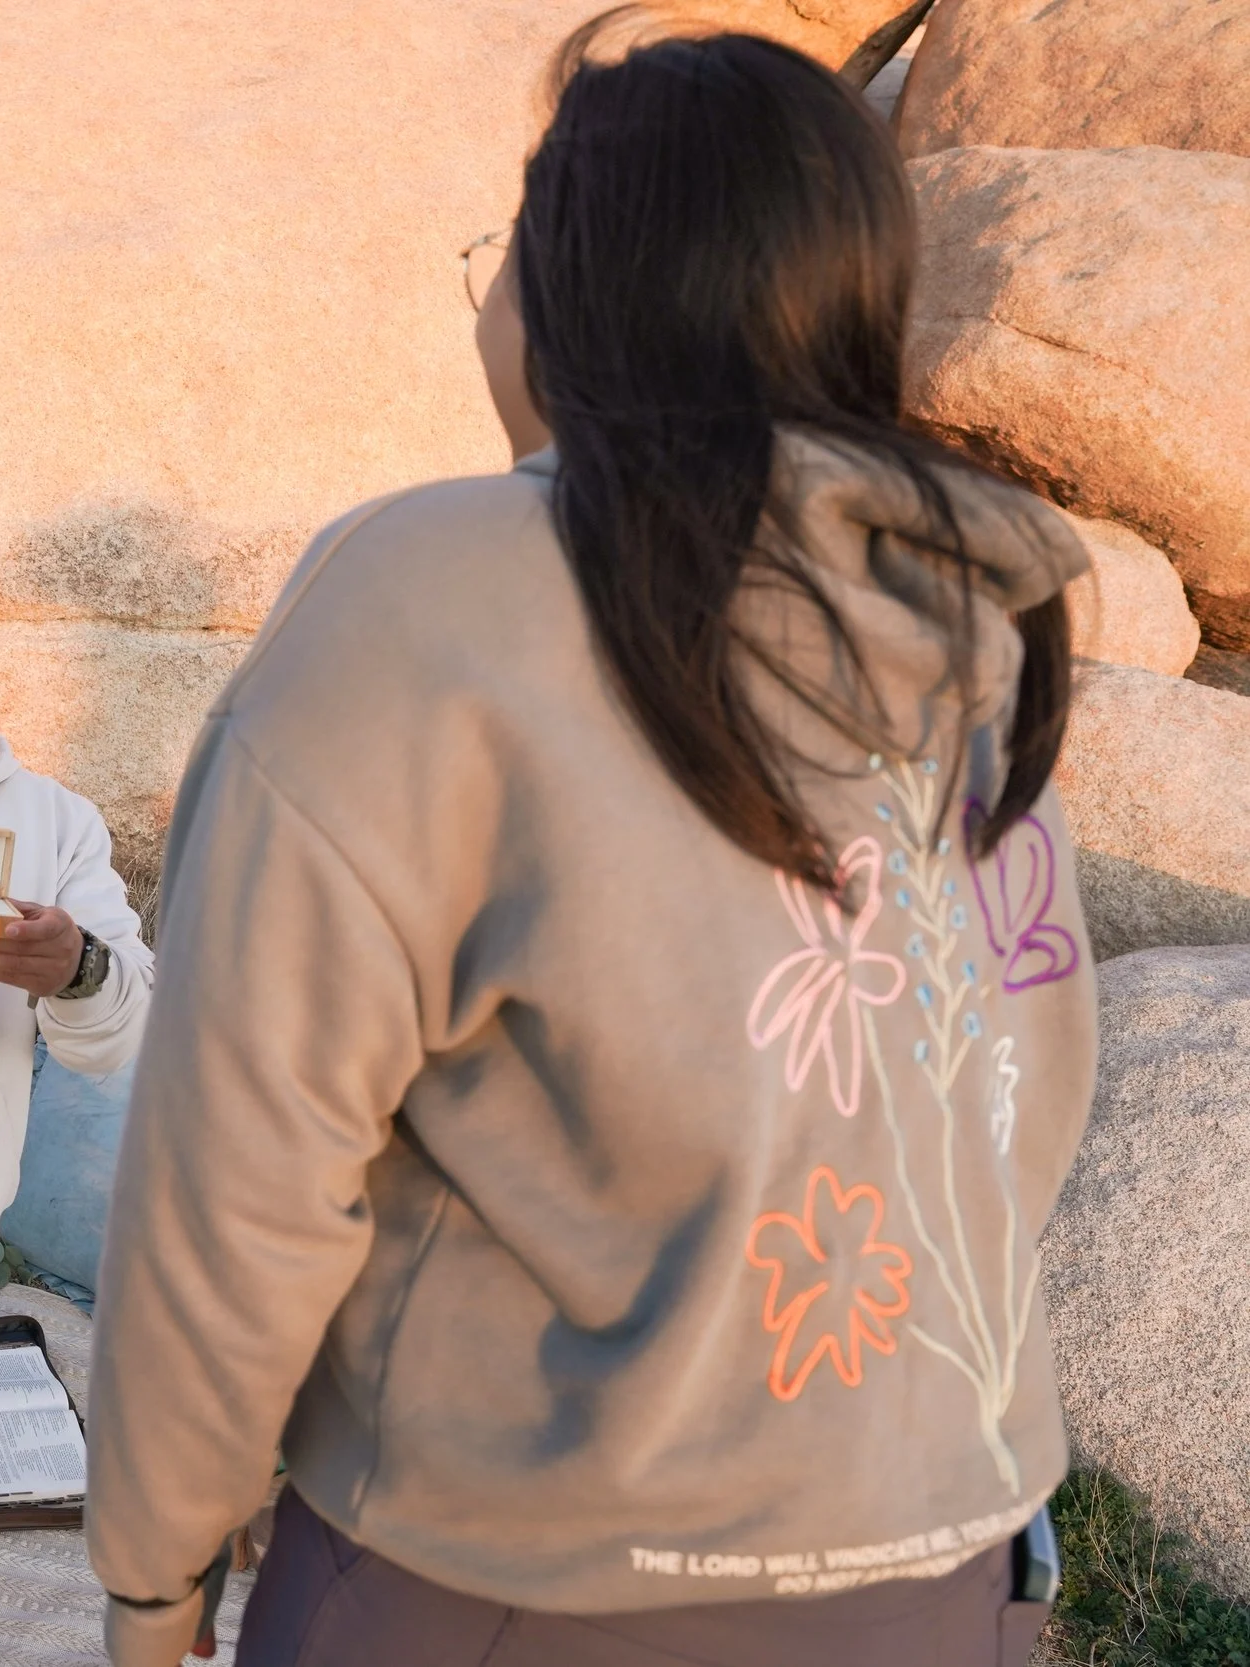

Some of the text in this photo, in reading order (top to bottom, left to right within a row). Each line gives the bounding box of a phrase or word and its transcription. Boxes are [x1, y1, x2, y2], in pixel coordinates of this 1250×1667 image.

[630, 1548, 684, 1575] THE
[687, 1553, 762, 1577] LORD
[765, 1552, 821, 1576] WILL
